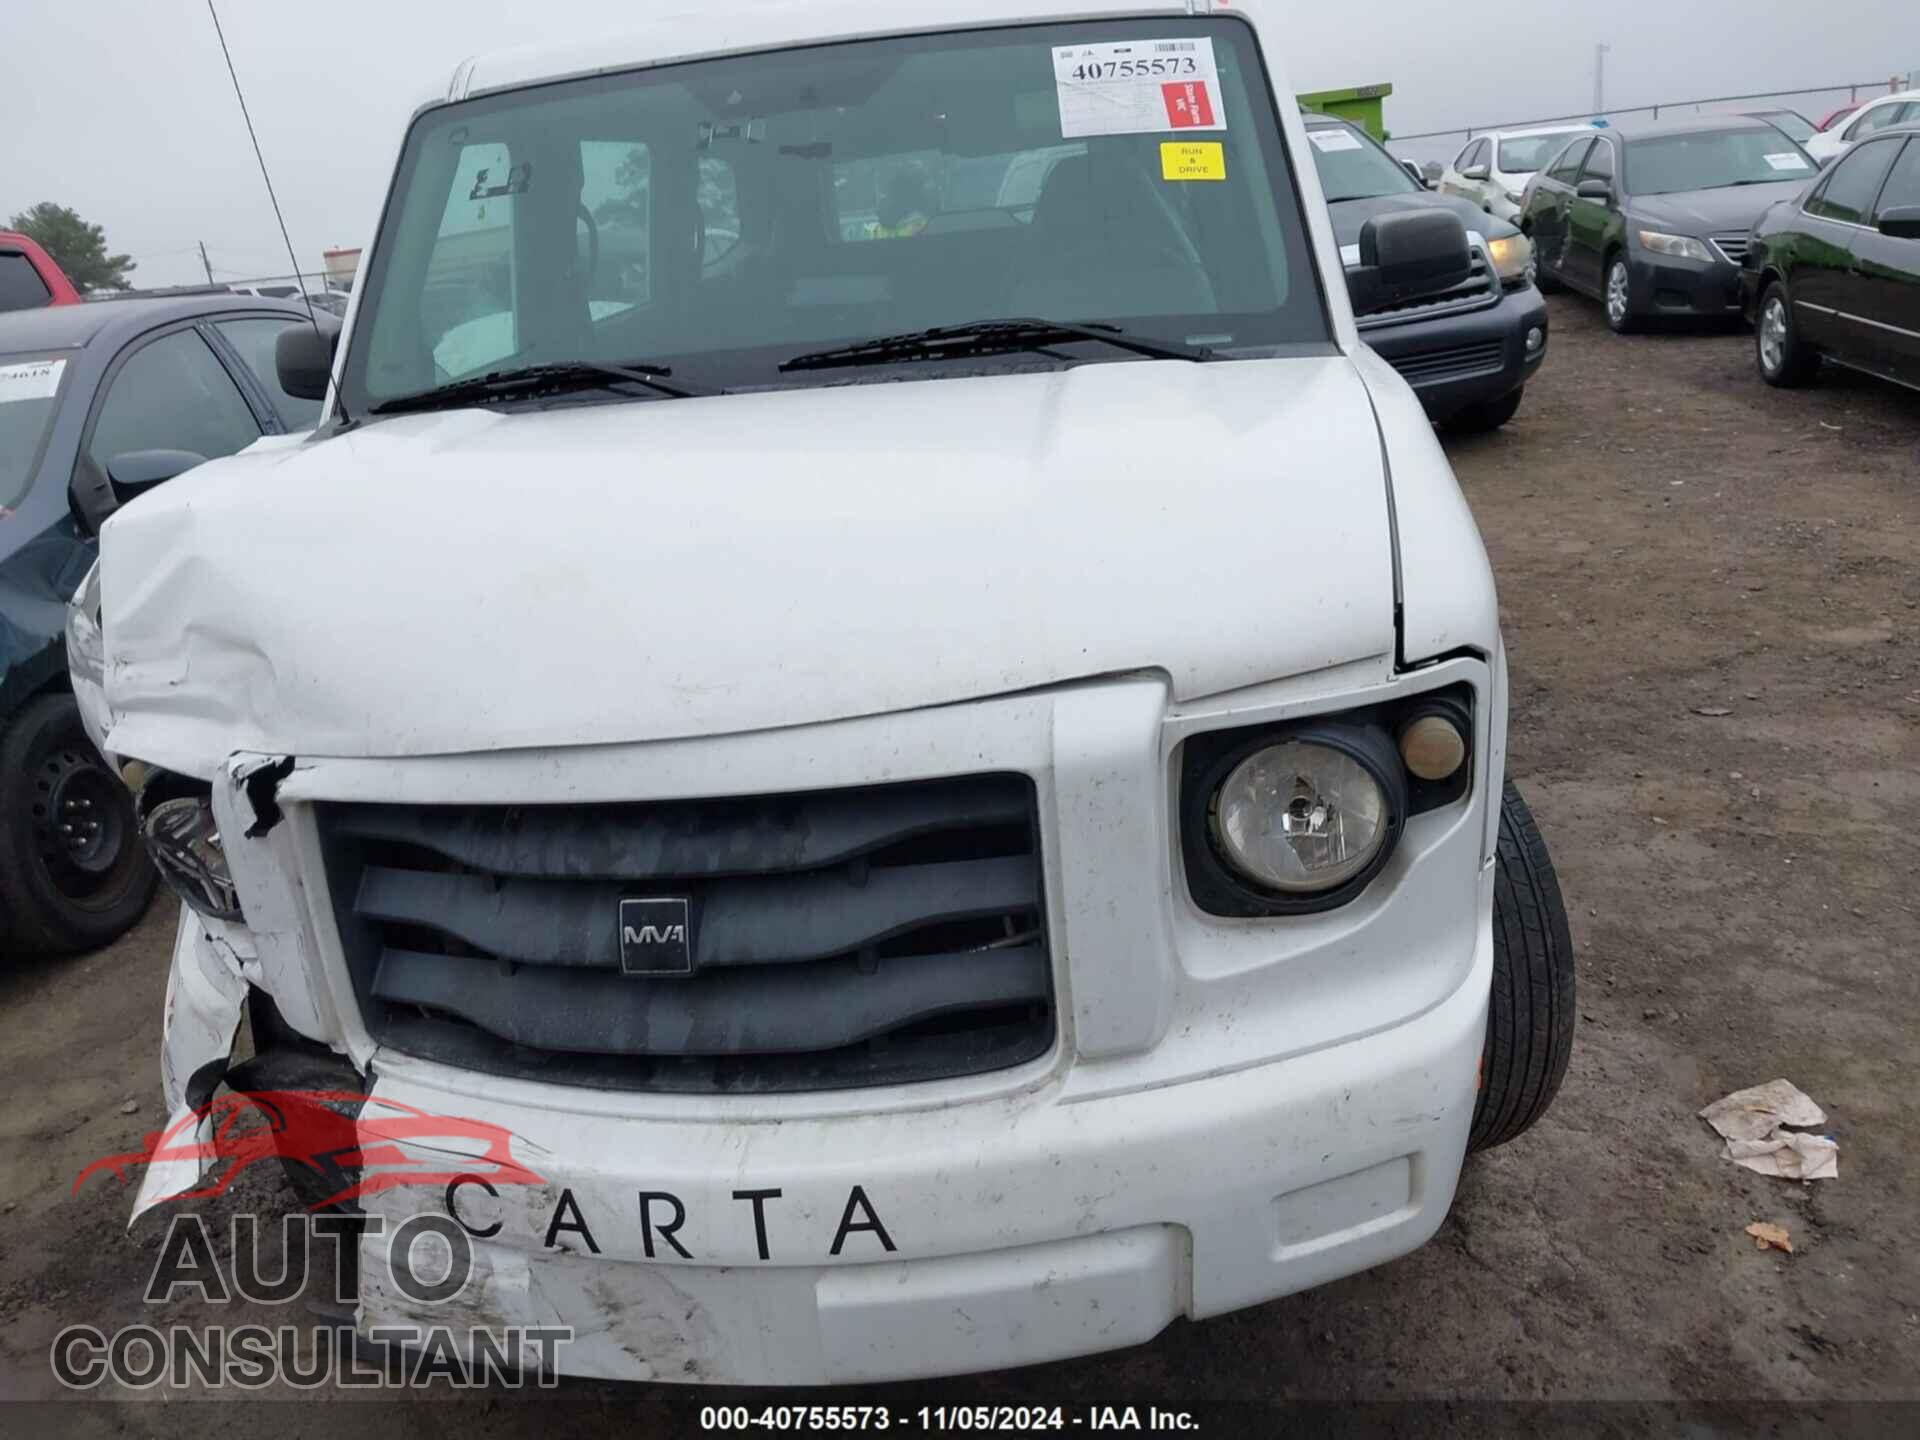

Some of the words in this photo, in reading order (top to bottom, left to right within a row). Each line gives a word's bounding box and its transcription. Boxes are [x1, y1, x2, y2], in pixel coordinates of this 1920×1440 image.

[1072, 57, 1196, 81] 40755573
[1181, 147, 1203, 155] RUN
[1179, 166, 1209, 174] DRIVE
[445, 1173, 898, 1260] CARTA
